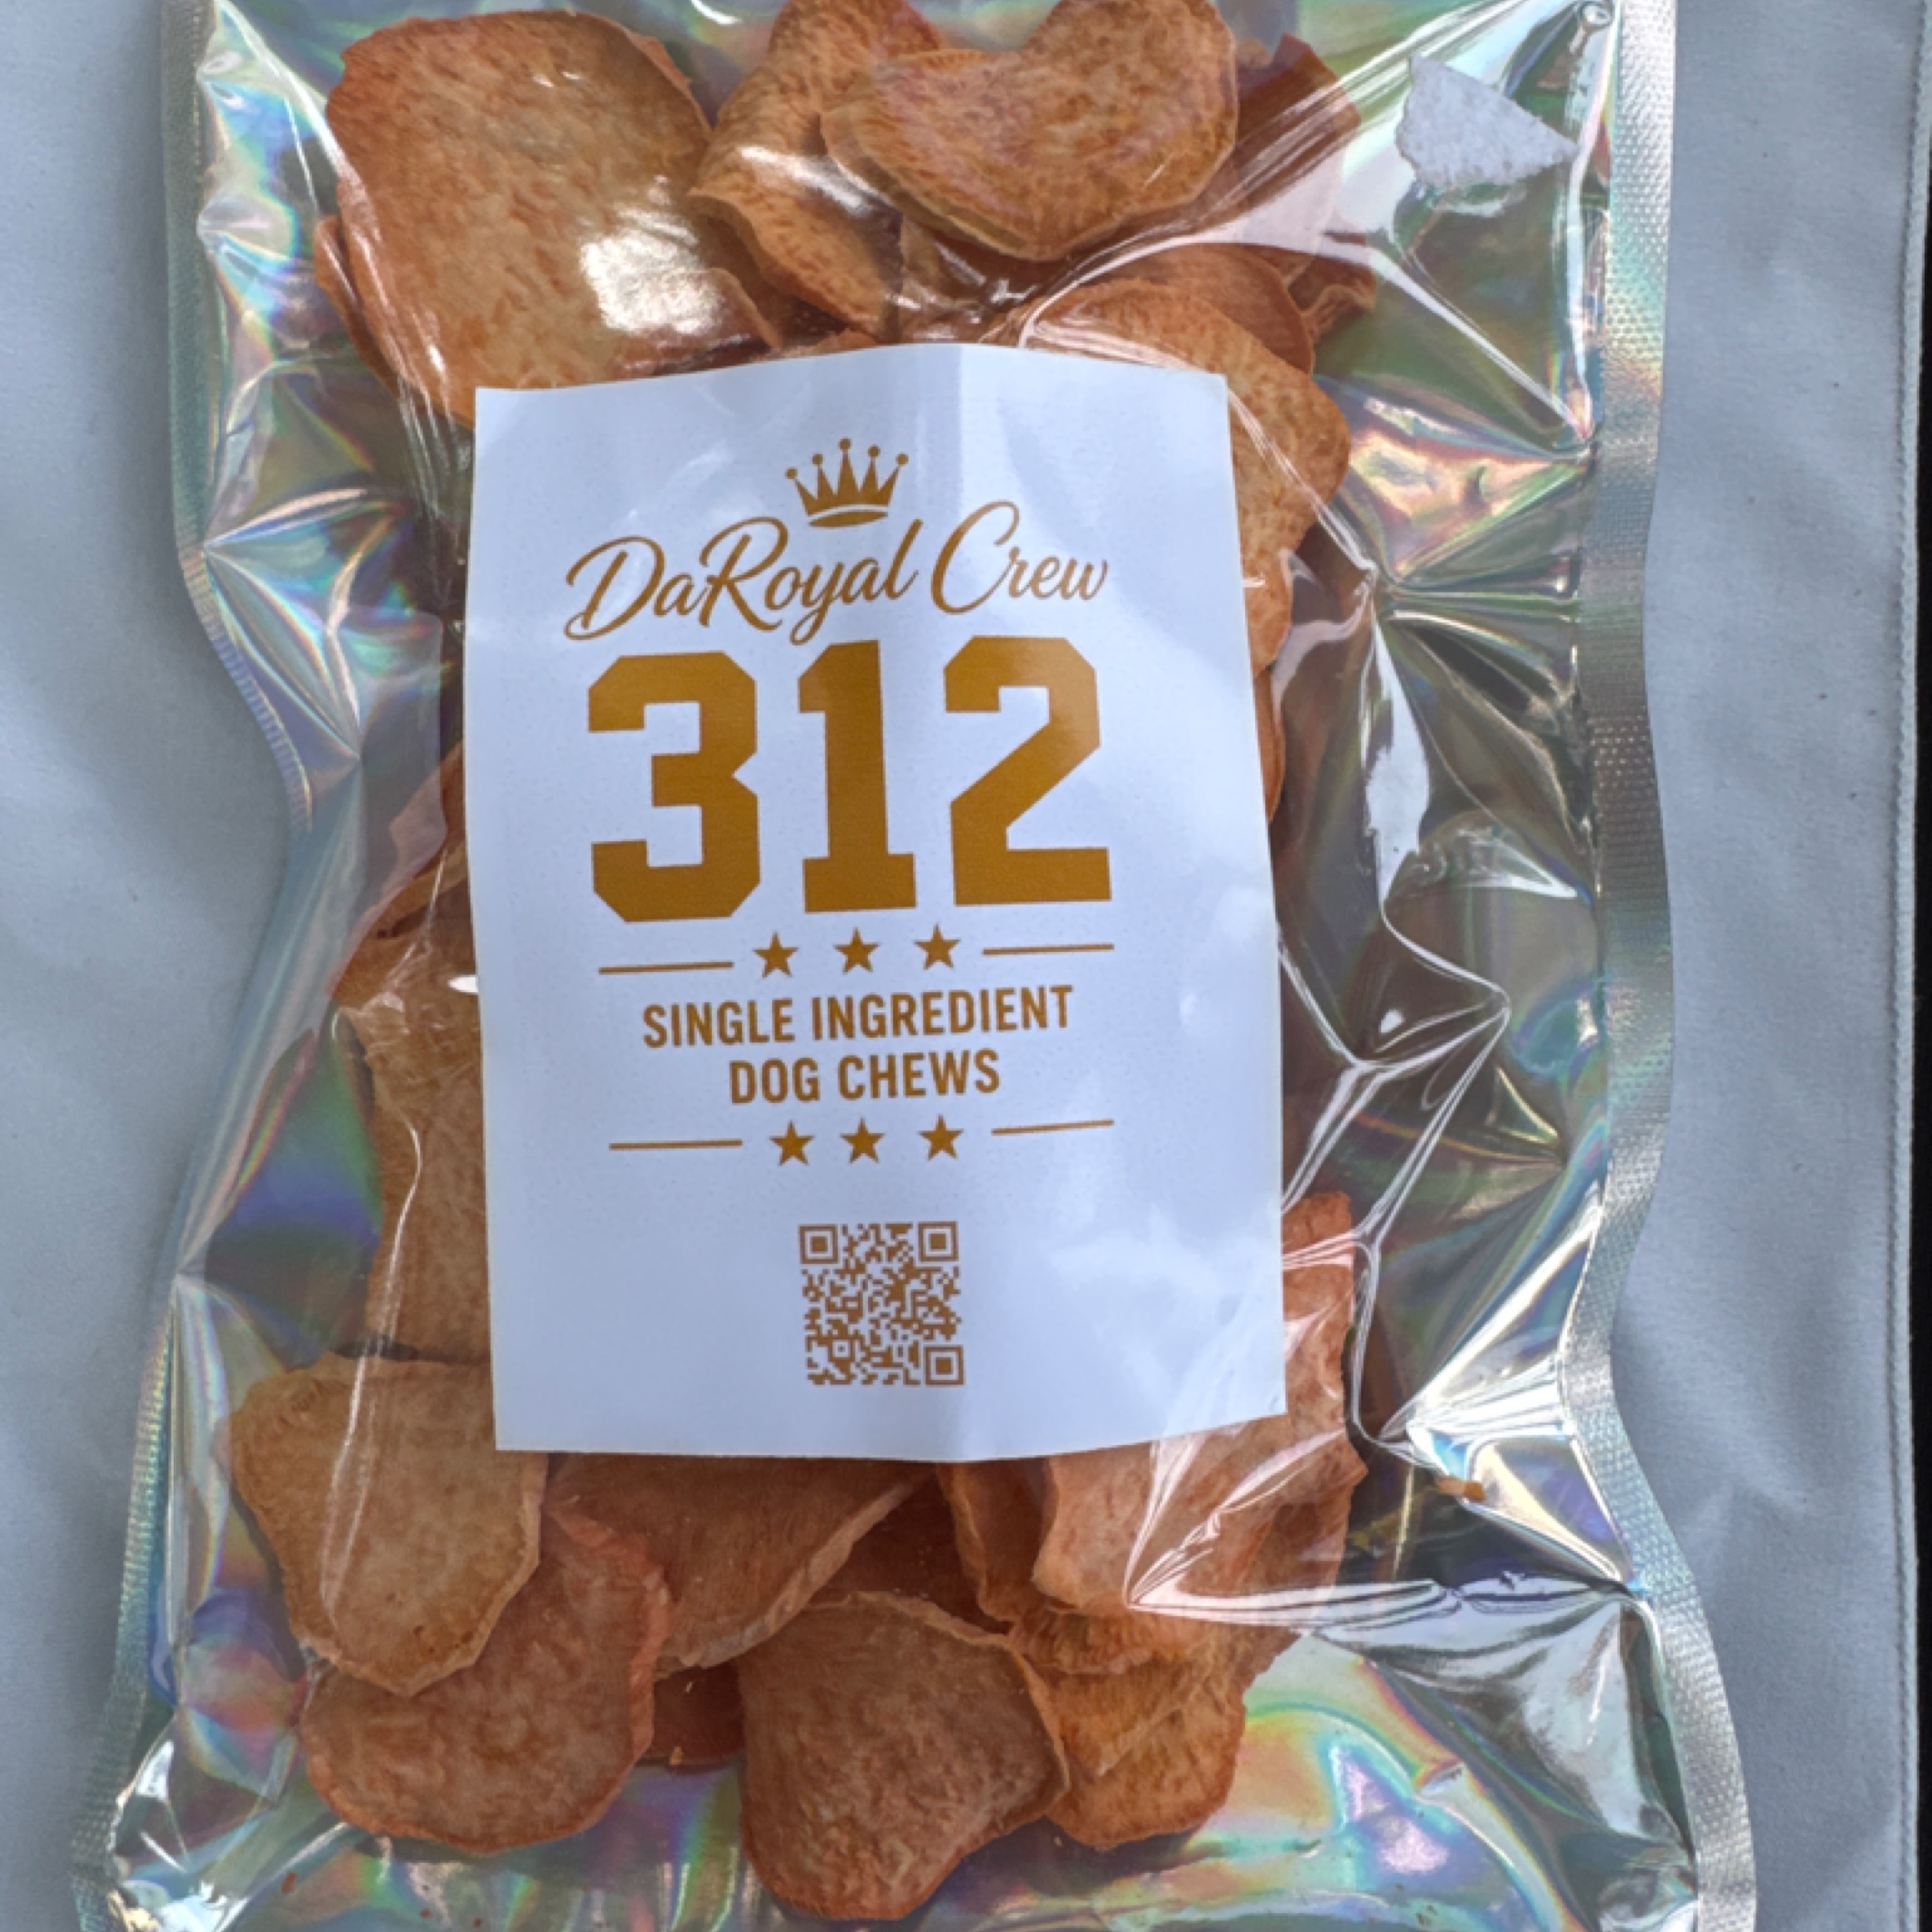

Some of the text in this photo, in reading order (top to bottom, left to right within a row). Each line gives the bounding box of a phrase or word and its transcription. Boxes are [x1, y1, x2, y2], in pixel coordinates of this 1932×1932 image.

[565, 502, 1109, 645] DaRoyal Crew
[588, 635, 1112, 923] 312
[643, 985, 1073, 1049] SINGLE INGREDIENT
[730, 1049, 1000, 1104] DOG CHEWS
